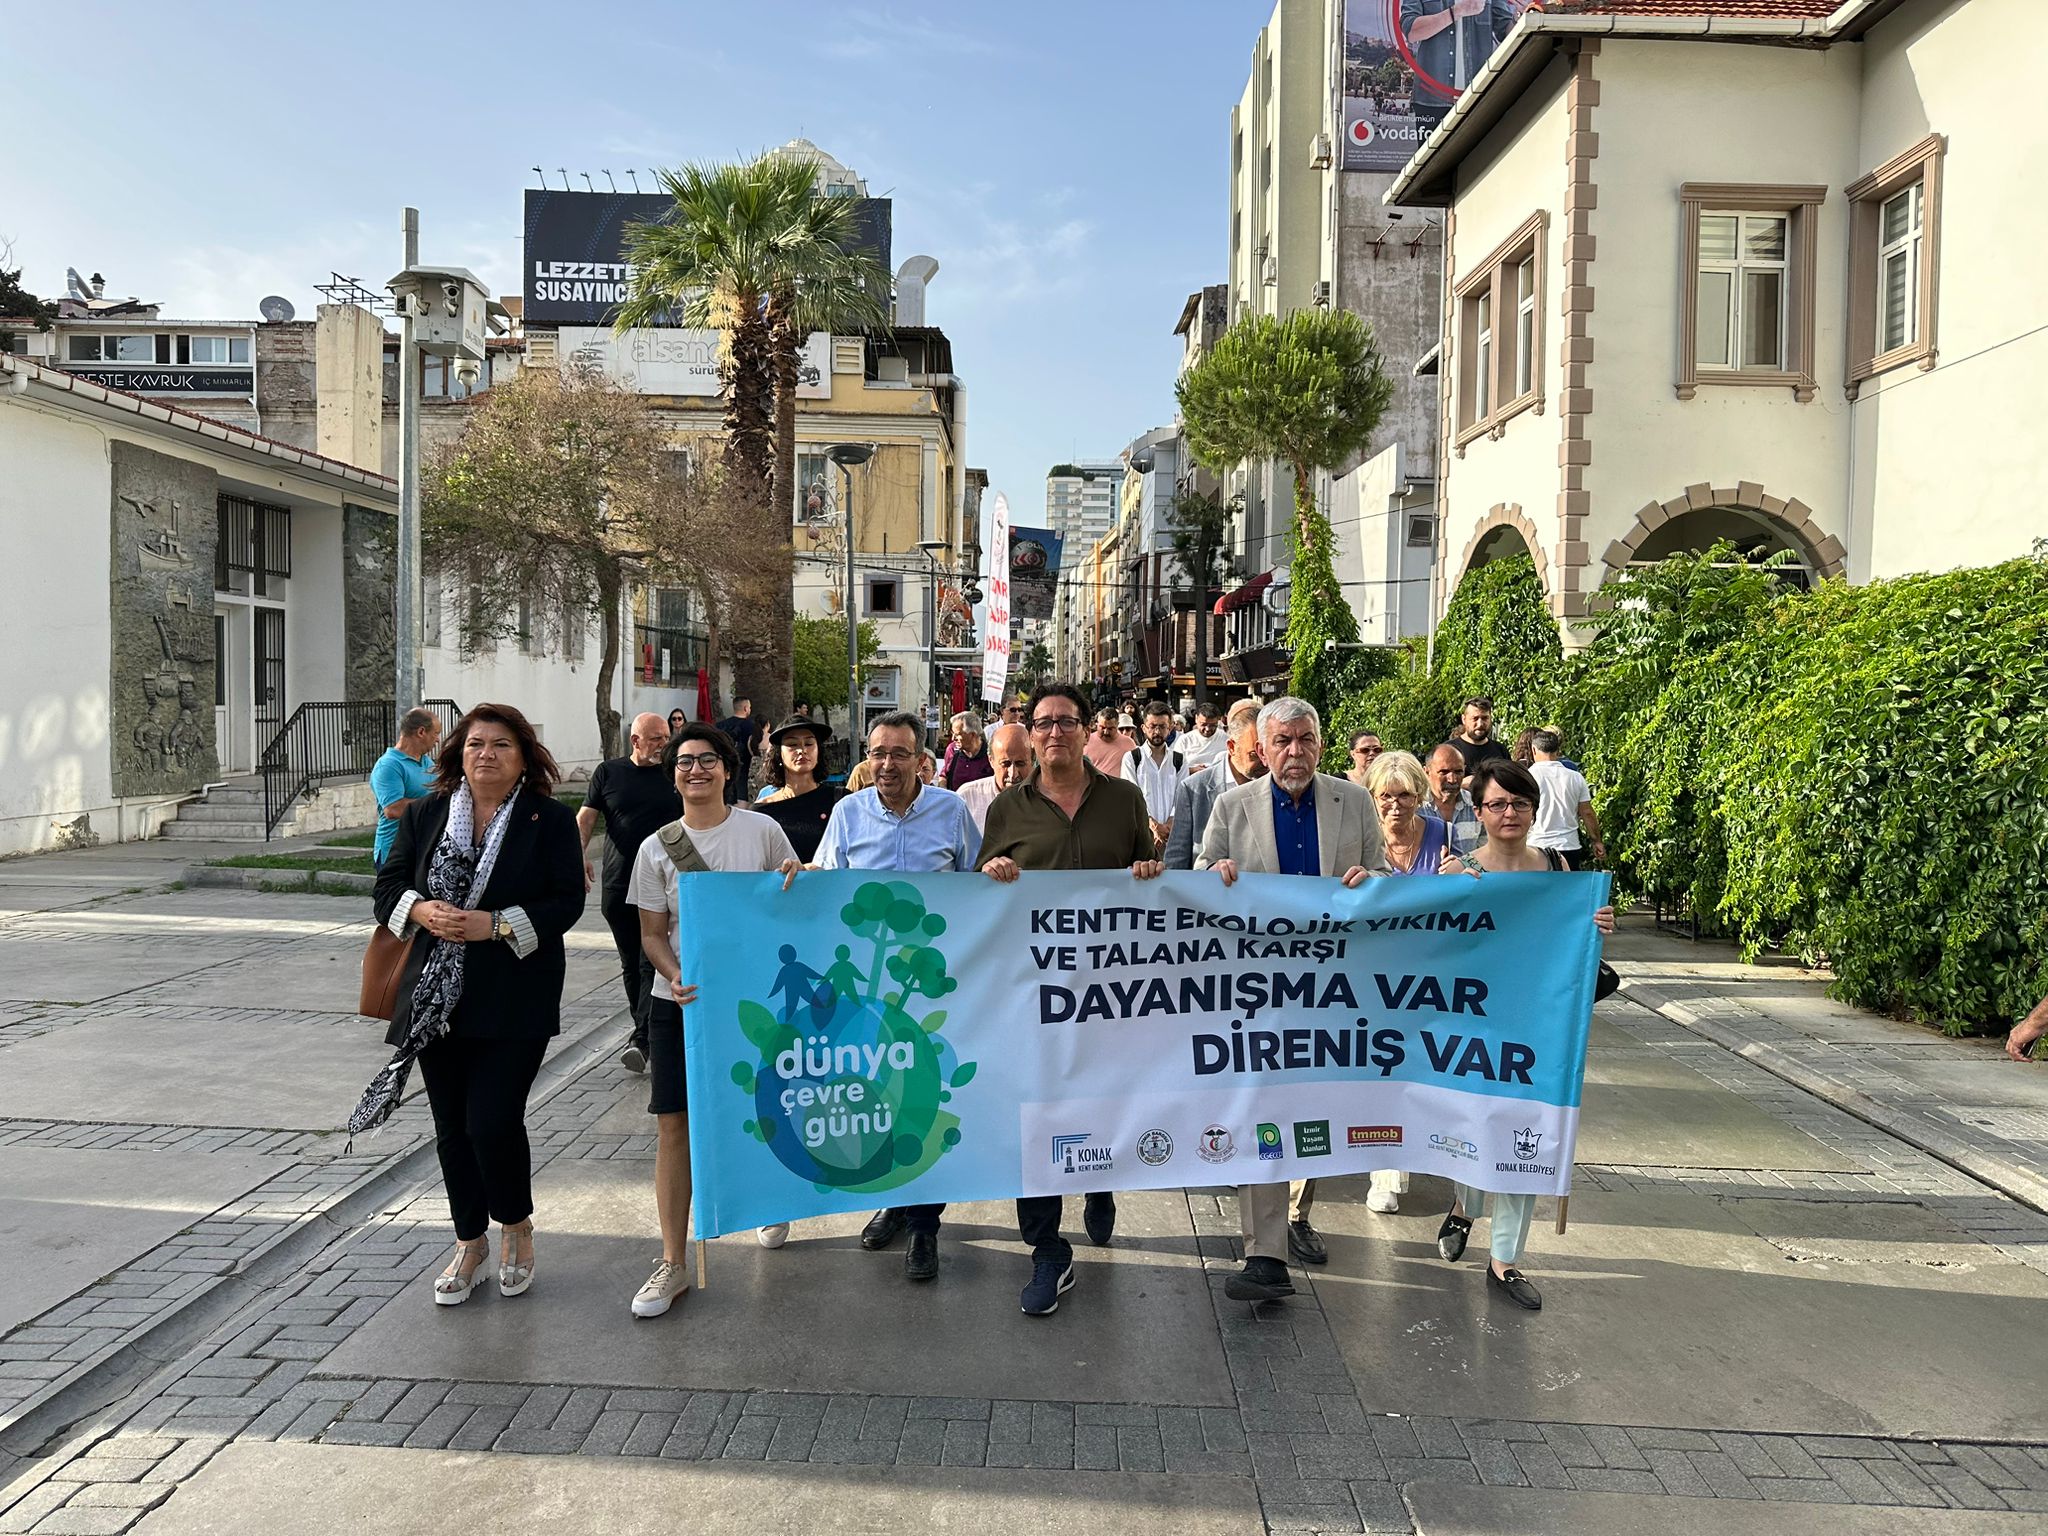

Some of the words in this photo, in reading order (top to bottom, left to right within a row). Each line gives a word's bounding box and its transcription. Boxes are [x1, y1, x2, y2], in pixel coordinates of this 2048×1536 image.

[129, 374, 195, 390] KAVRUK
[1031, 907, 1167, 934] KENTTE
[1175, 907, 1362, 936] EKOLOJİK
[1366, 911, 1496, 934] YIKIMA
[1030, 946, 1077, 971] VE
[1086, 938, 1225, 970] TALANA
[1237, 939, 1346, 964] KARŞI
[1040, 972, 1360, 1024] DAYANIŞMA
[1374, 974, 1488, 1016] VAR
[775, 1035, 915, 1080] dünya
[1193, 1018, 1405, 1076] DİRENİŞ
[1420, 1030, 1536, 1085] VAR
[780, 1082, 864, 1116] çevre
[805, 1103, 892, 1147] günü
[1303, 1125, 1320, 1133] İzmir
[1351, 1128, 1398, 1139] tmmob
[1078, 1147, 1112, 1162] KONAK
[1495, 1162, 1517, 1172] KONAK
[1519, 1163, 1556, 1176] BELEDİYESİ
